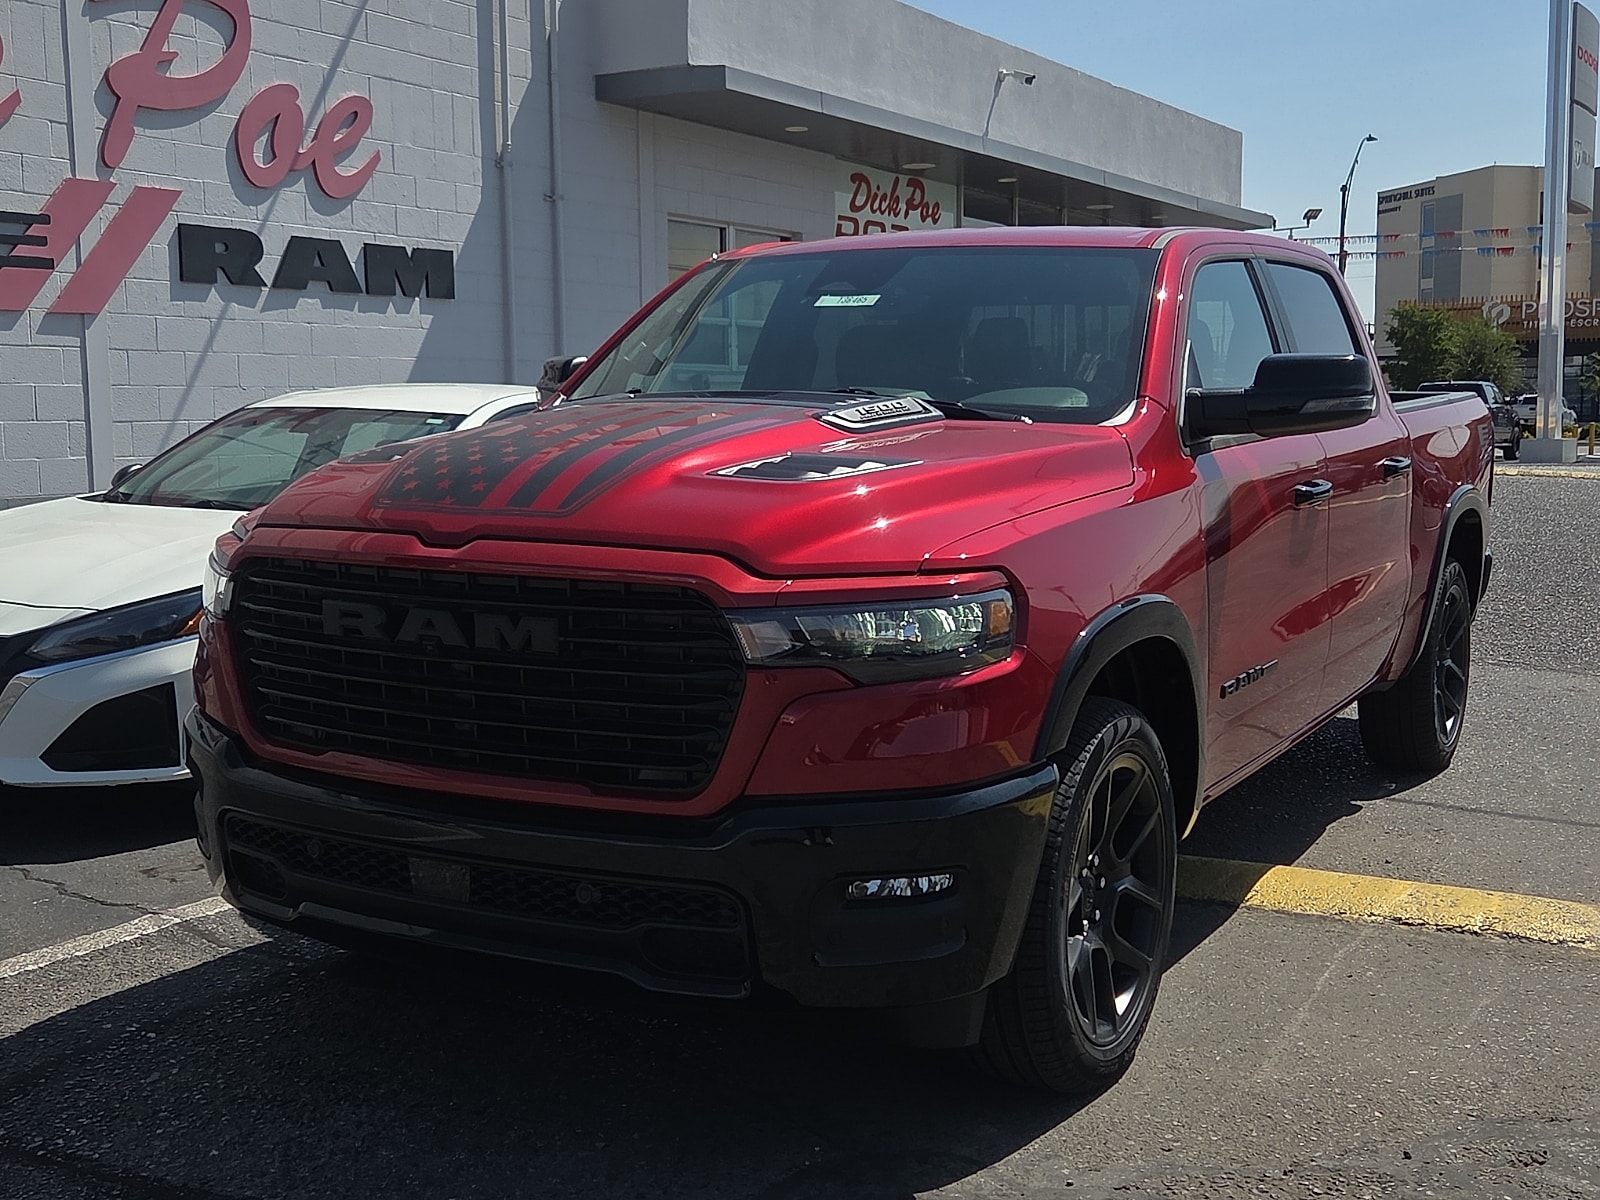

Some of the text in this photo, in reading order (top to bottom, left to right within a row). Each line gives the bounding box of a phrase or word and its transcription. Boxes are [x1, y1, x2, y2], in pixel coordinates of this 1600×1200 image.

[89, 0, 381, 199] Poe
[849, 172, 941, 225] Dick Poe
[1414, 186, 1435, 198] SUITES
[177, 223, 455, 299] RAM
[855, 402, 907, 415] 1500
[321, 599, 560, 655] RAM
